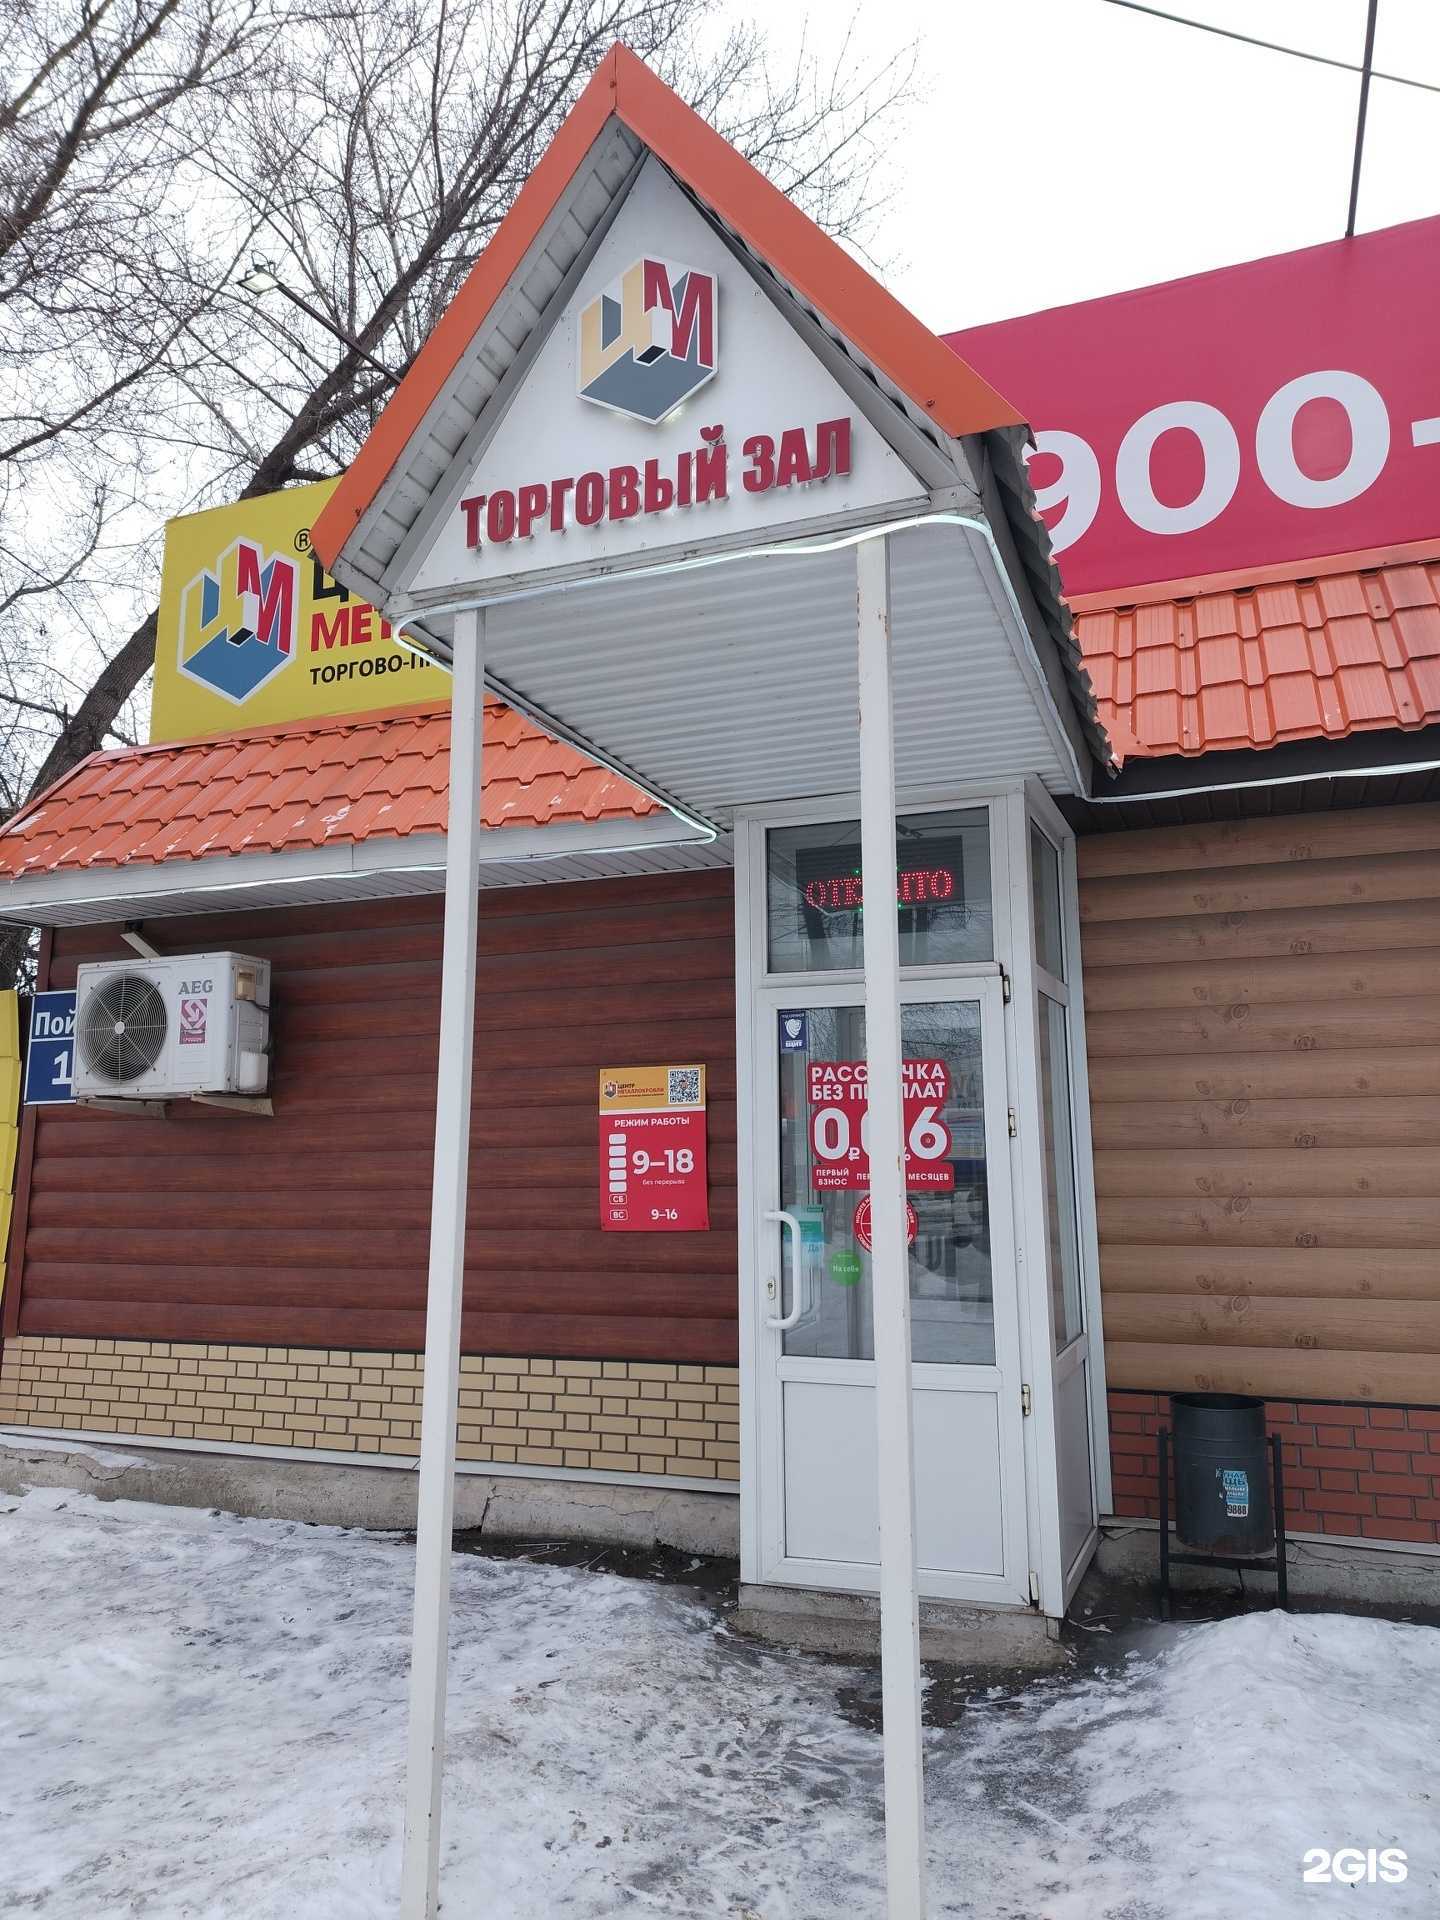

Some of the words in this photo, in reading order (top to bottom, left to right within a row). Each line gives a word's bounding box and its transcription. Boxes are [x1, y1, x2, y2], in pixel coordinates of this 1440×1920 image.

[460, 424, 728, 550] ТОРГОВЫЙ
[742, 417, 852, 494] ЗАЛ
[310, 653, 430, 685] ТОРГОВО-П
[805, 870, 952, 907] ОТКТО
[178, 980, 213, 994] AEG
[51, 1051, 72, 1085] 1
[811, 1063, 945, 1082] РАССЧКА
[812, 1084, 843, 1100] БЕЗ
[850, 1082, 945, 1100] ПЛАТ
[614, 1118, 649, 1128] РЕЖИМ
[651, 1117, 690, 1127] РАБОТЫ
[909, 1106, 947, 1160] 6
[816, 1168, 849, 1176] ПЕРВЫЙ
[908, 1173, 949, 1182] МЕСЯЦЕВ
[613, 1211, 625, 1219] ВС
